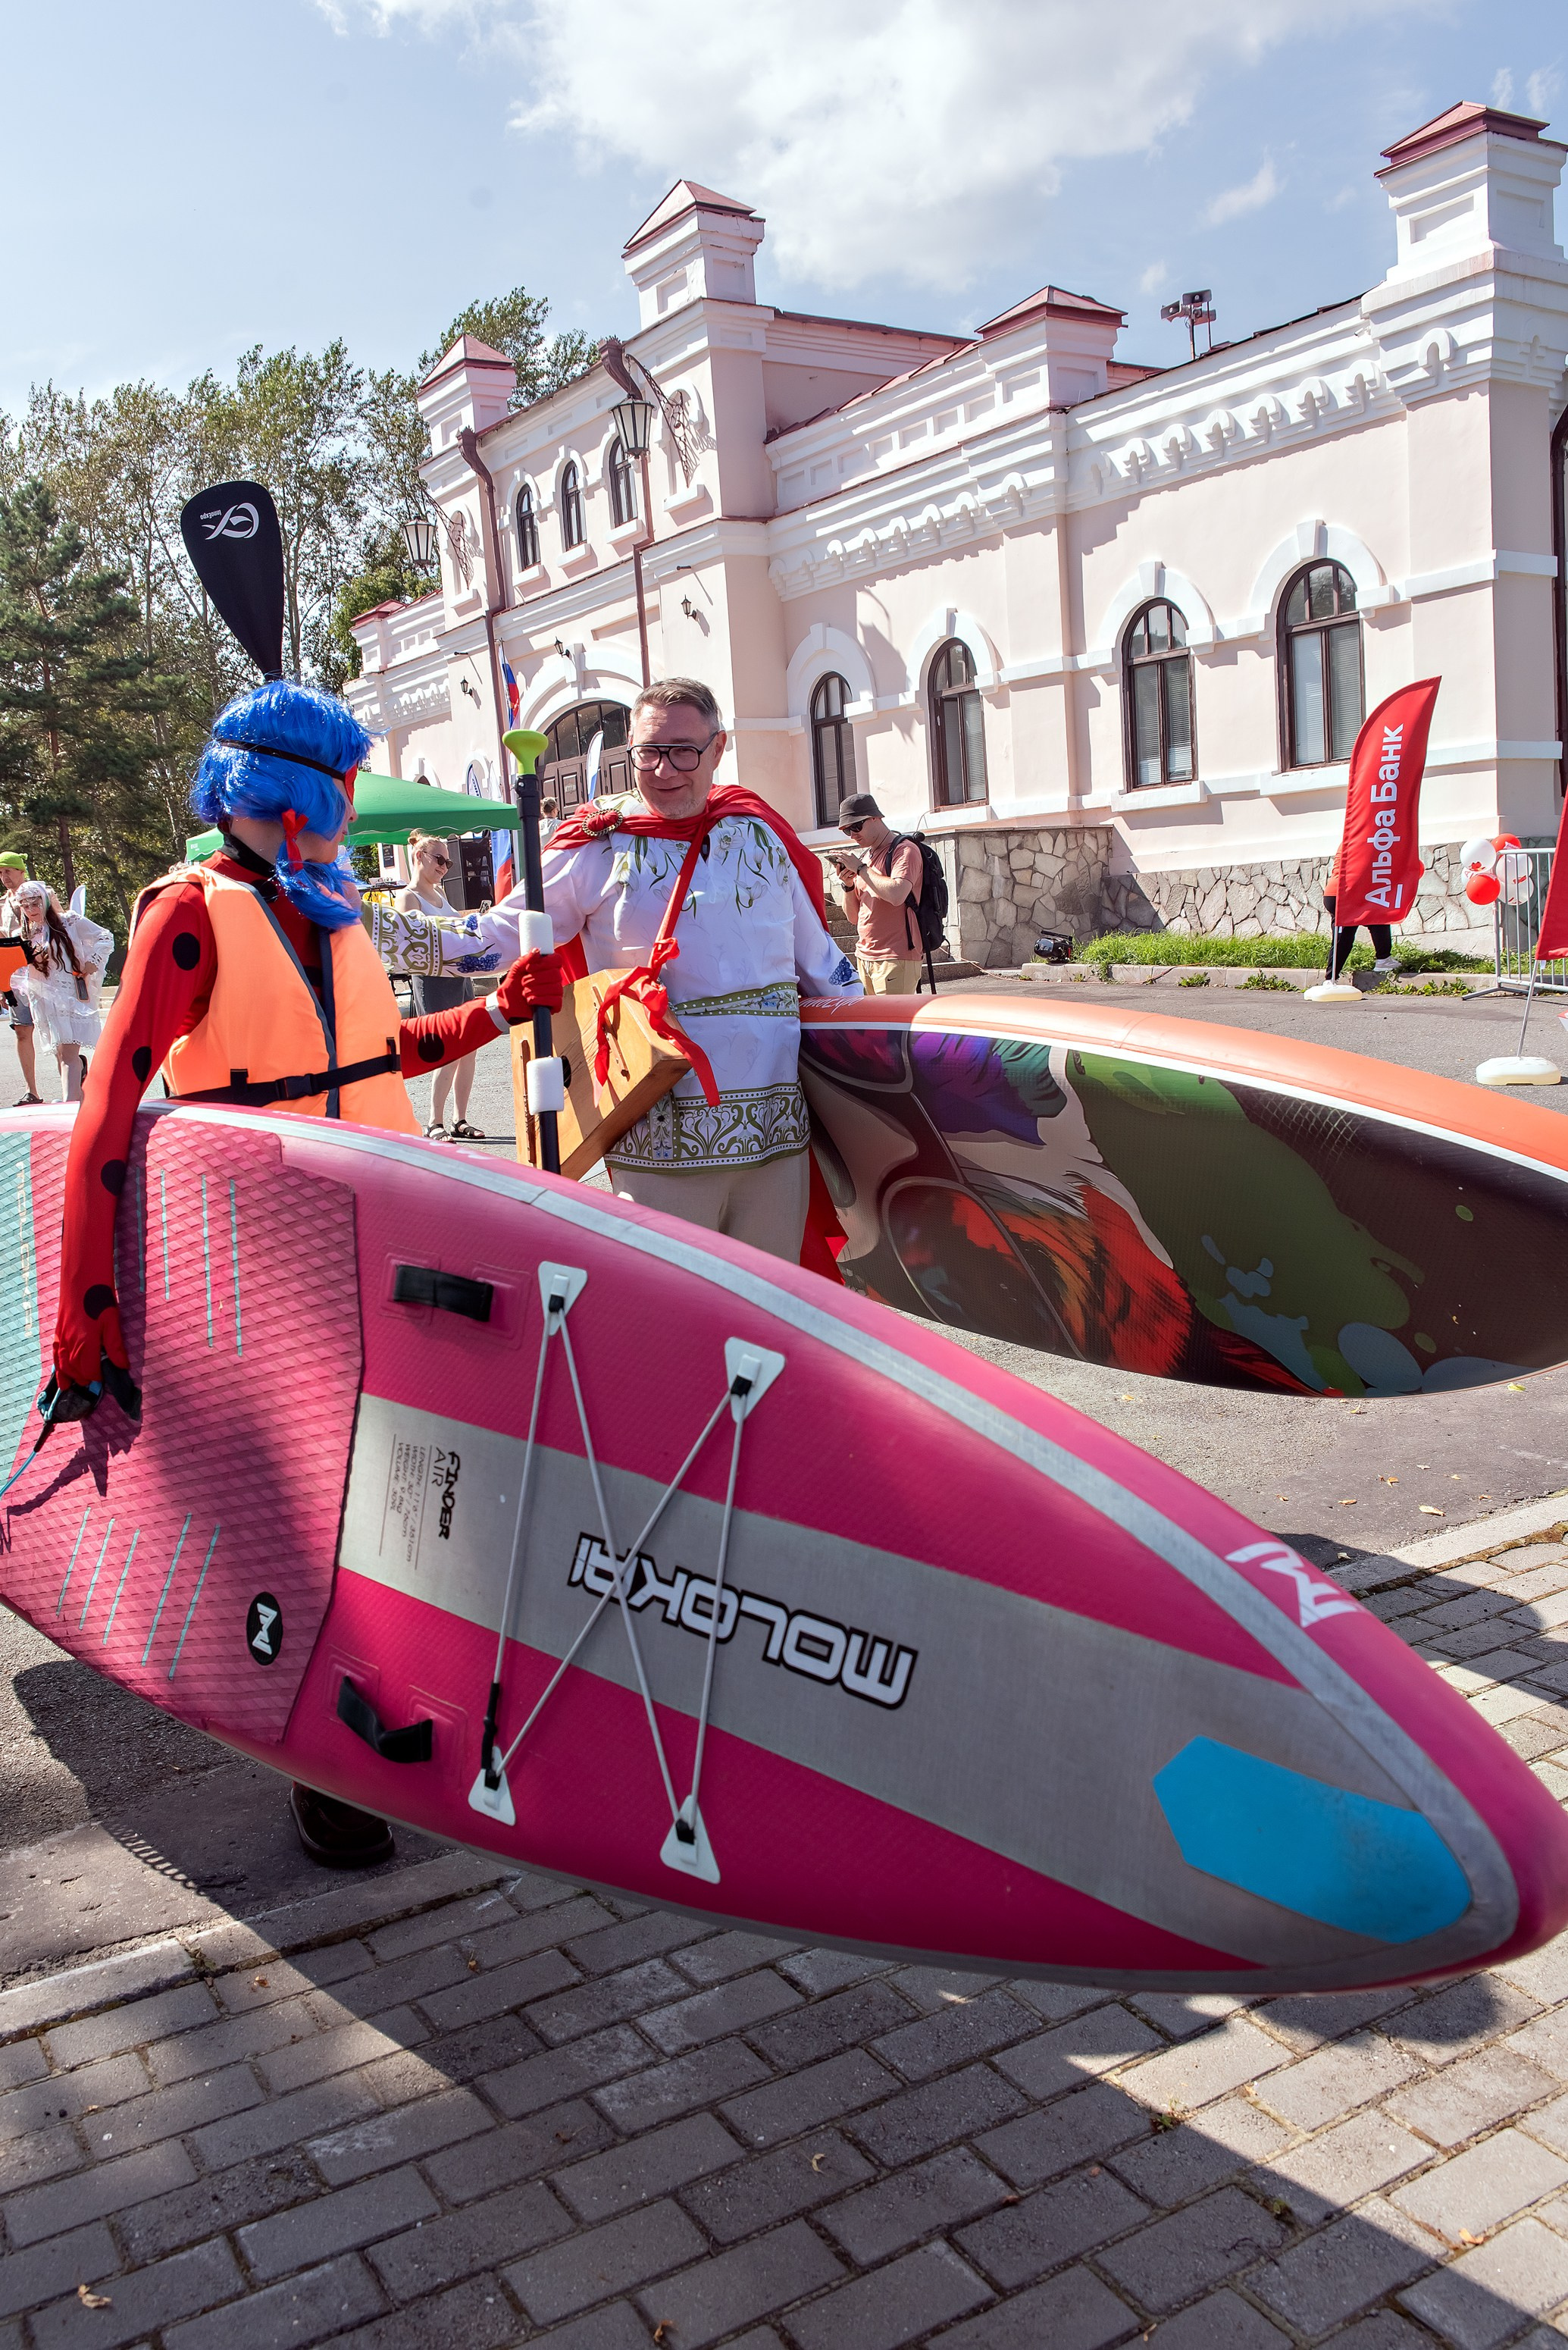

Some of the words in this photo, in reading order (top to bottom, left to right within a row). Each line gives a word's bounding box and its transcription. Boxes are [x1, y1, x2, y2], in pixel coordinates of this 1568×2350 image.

[1370, 723, 1404, 803] Банк
[1365, 809, 1401, 908] Альфа
[431, 1446, 446, 1487] AIR
[439, 1450, 460, 1540] FINDER
